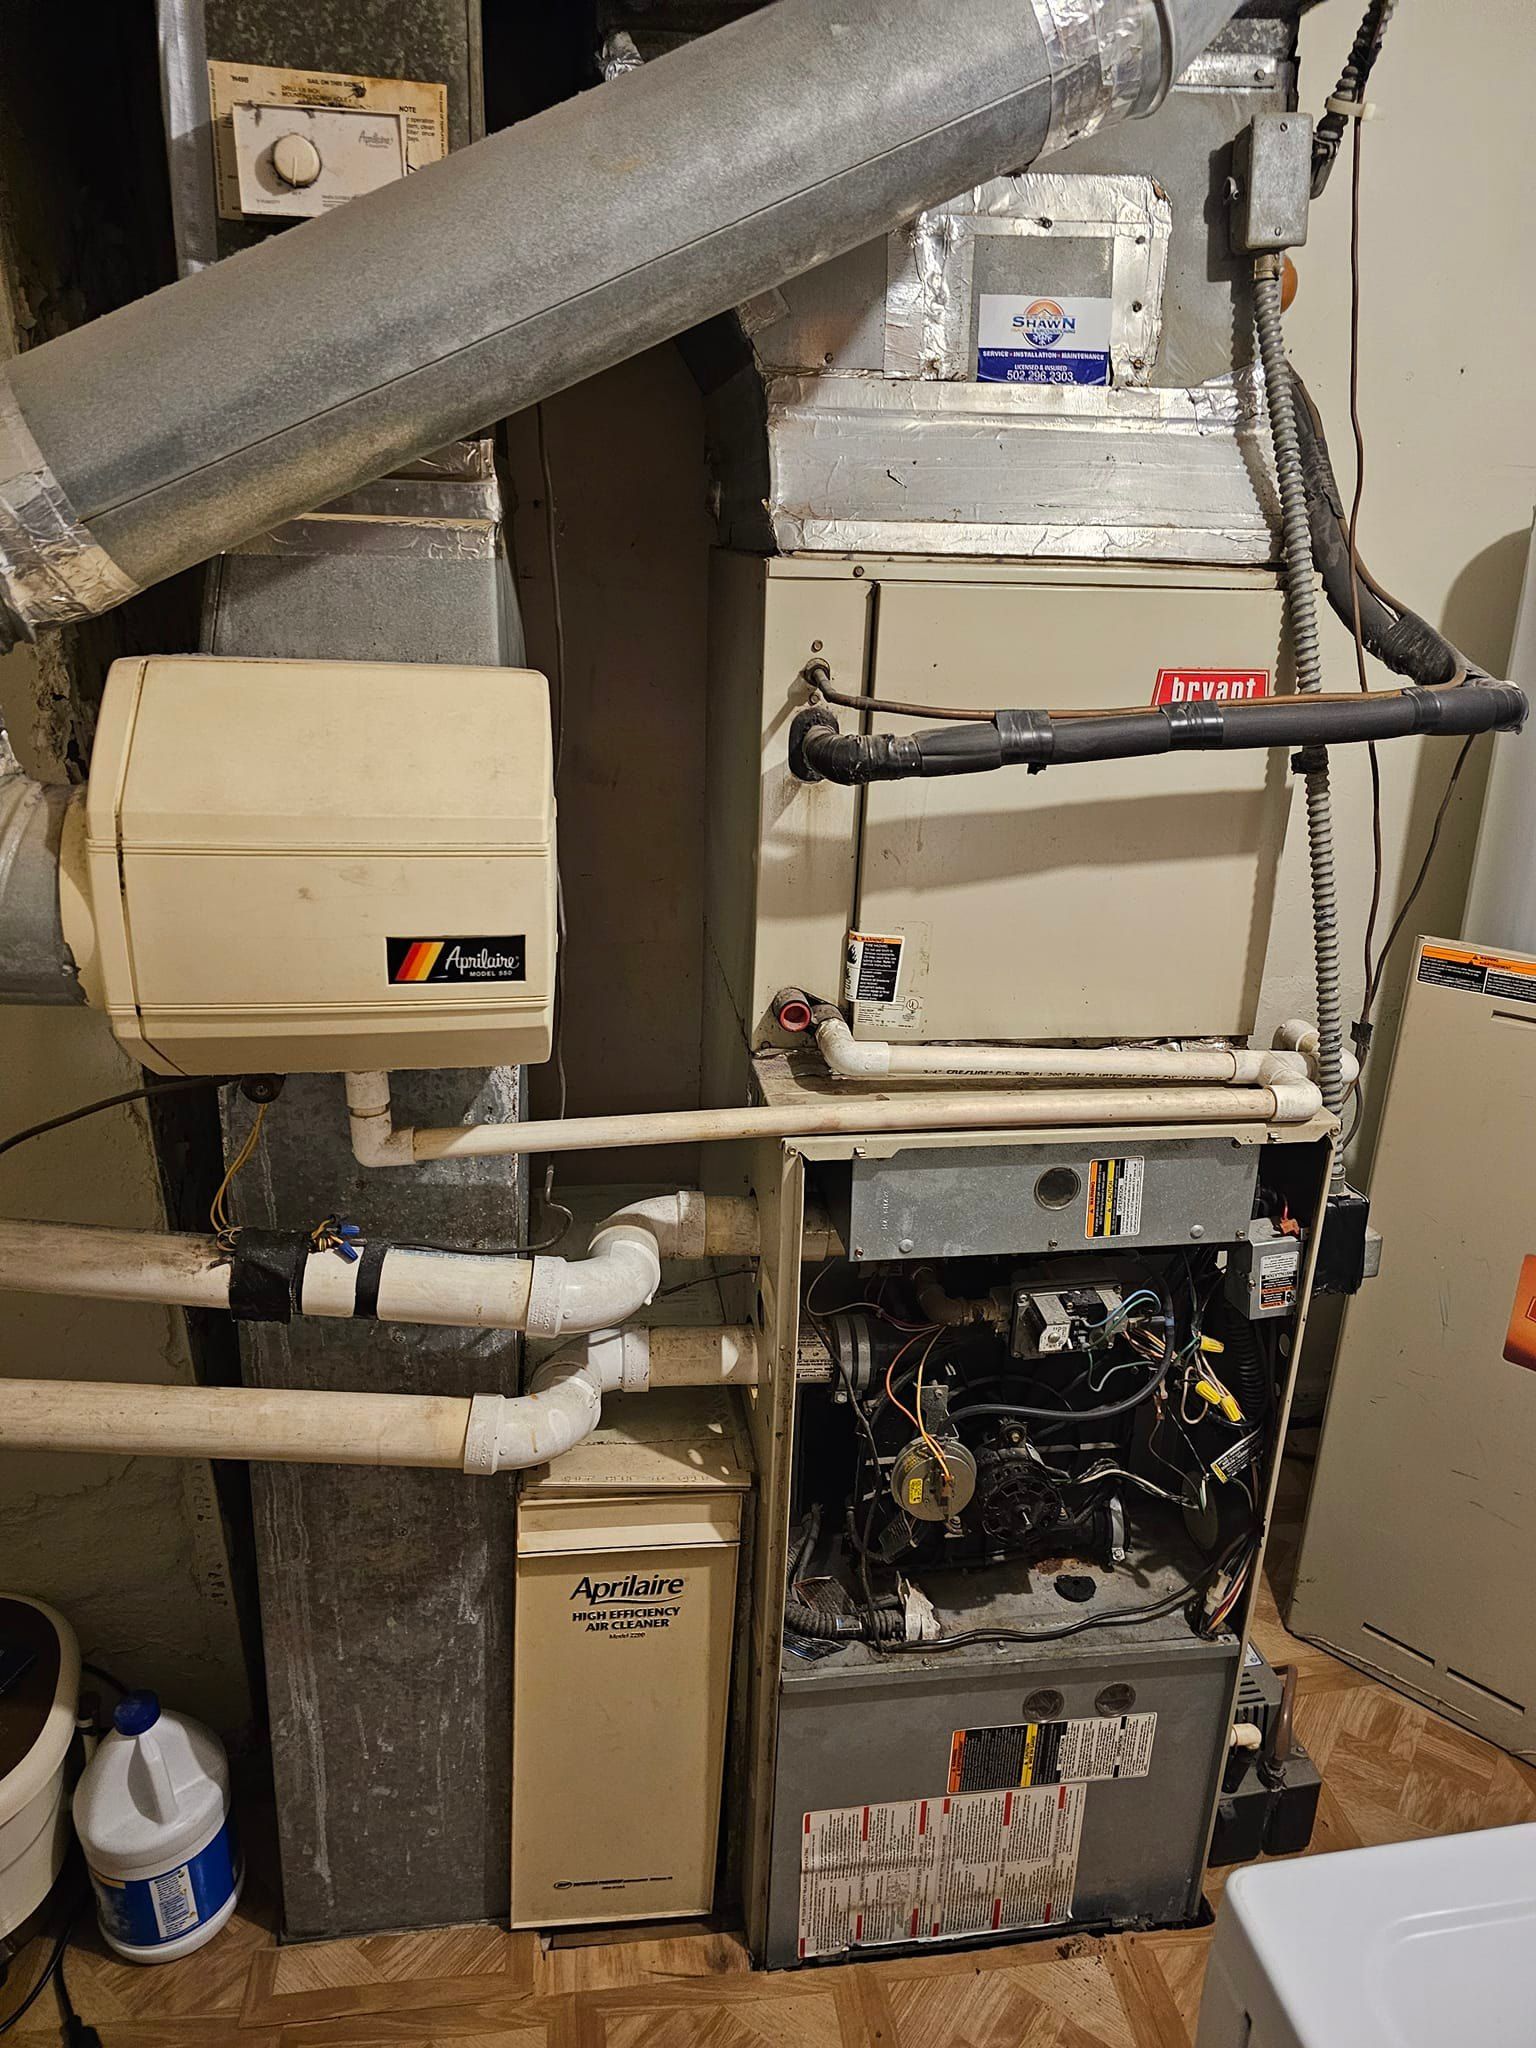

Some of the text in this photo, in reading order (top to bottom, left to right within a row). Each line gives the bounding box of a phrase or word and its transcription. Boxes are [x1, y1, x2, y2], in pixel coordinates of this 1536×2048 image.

[399, 105, 416, 114] NOTE
[1012, 316, 1076, 330] SHAWN
[982, 350, 1105, 361] SERVICE INSTALLATION MAINTENANCE
[1006, 370, 1074, 382] 502.296.2303
[445, 945, 520, 975] Aprilaire
[570, 1574, 685, 1606] Aprilaire
[572, 1606, 681, 1622] HIGH EFFICIENCY
[585, 1618, 670, 1632] AIR CLEANER
